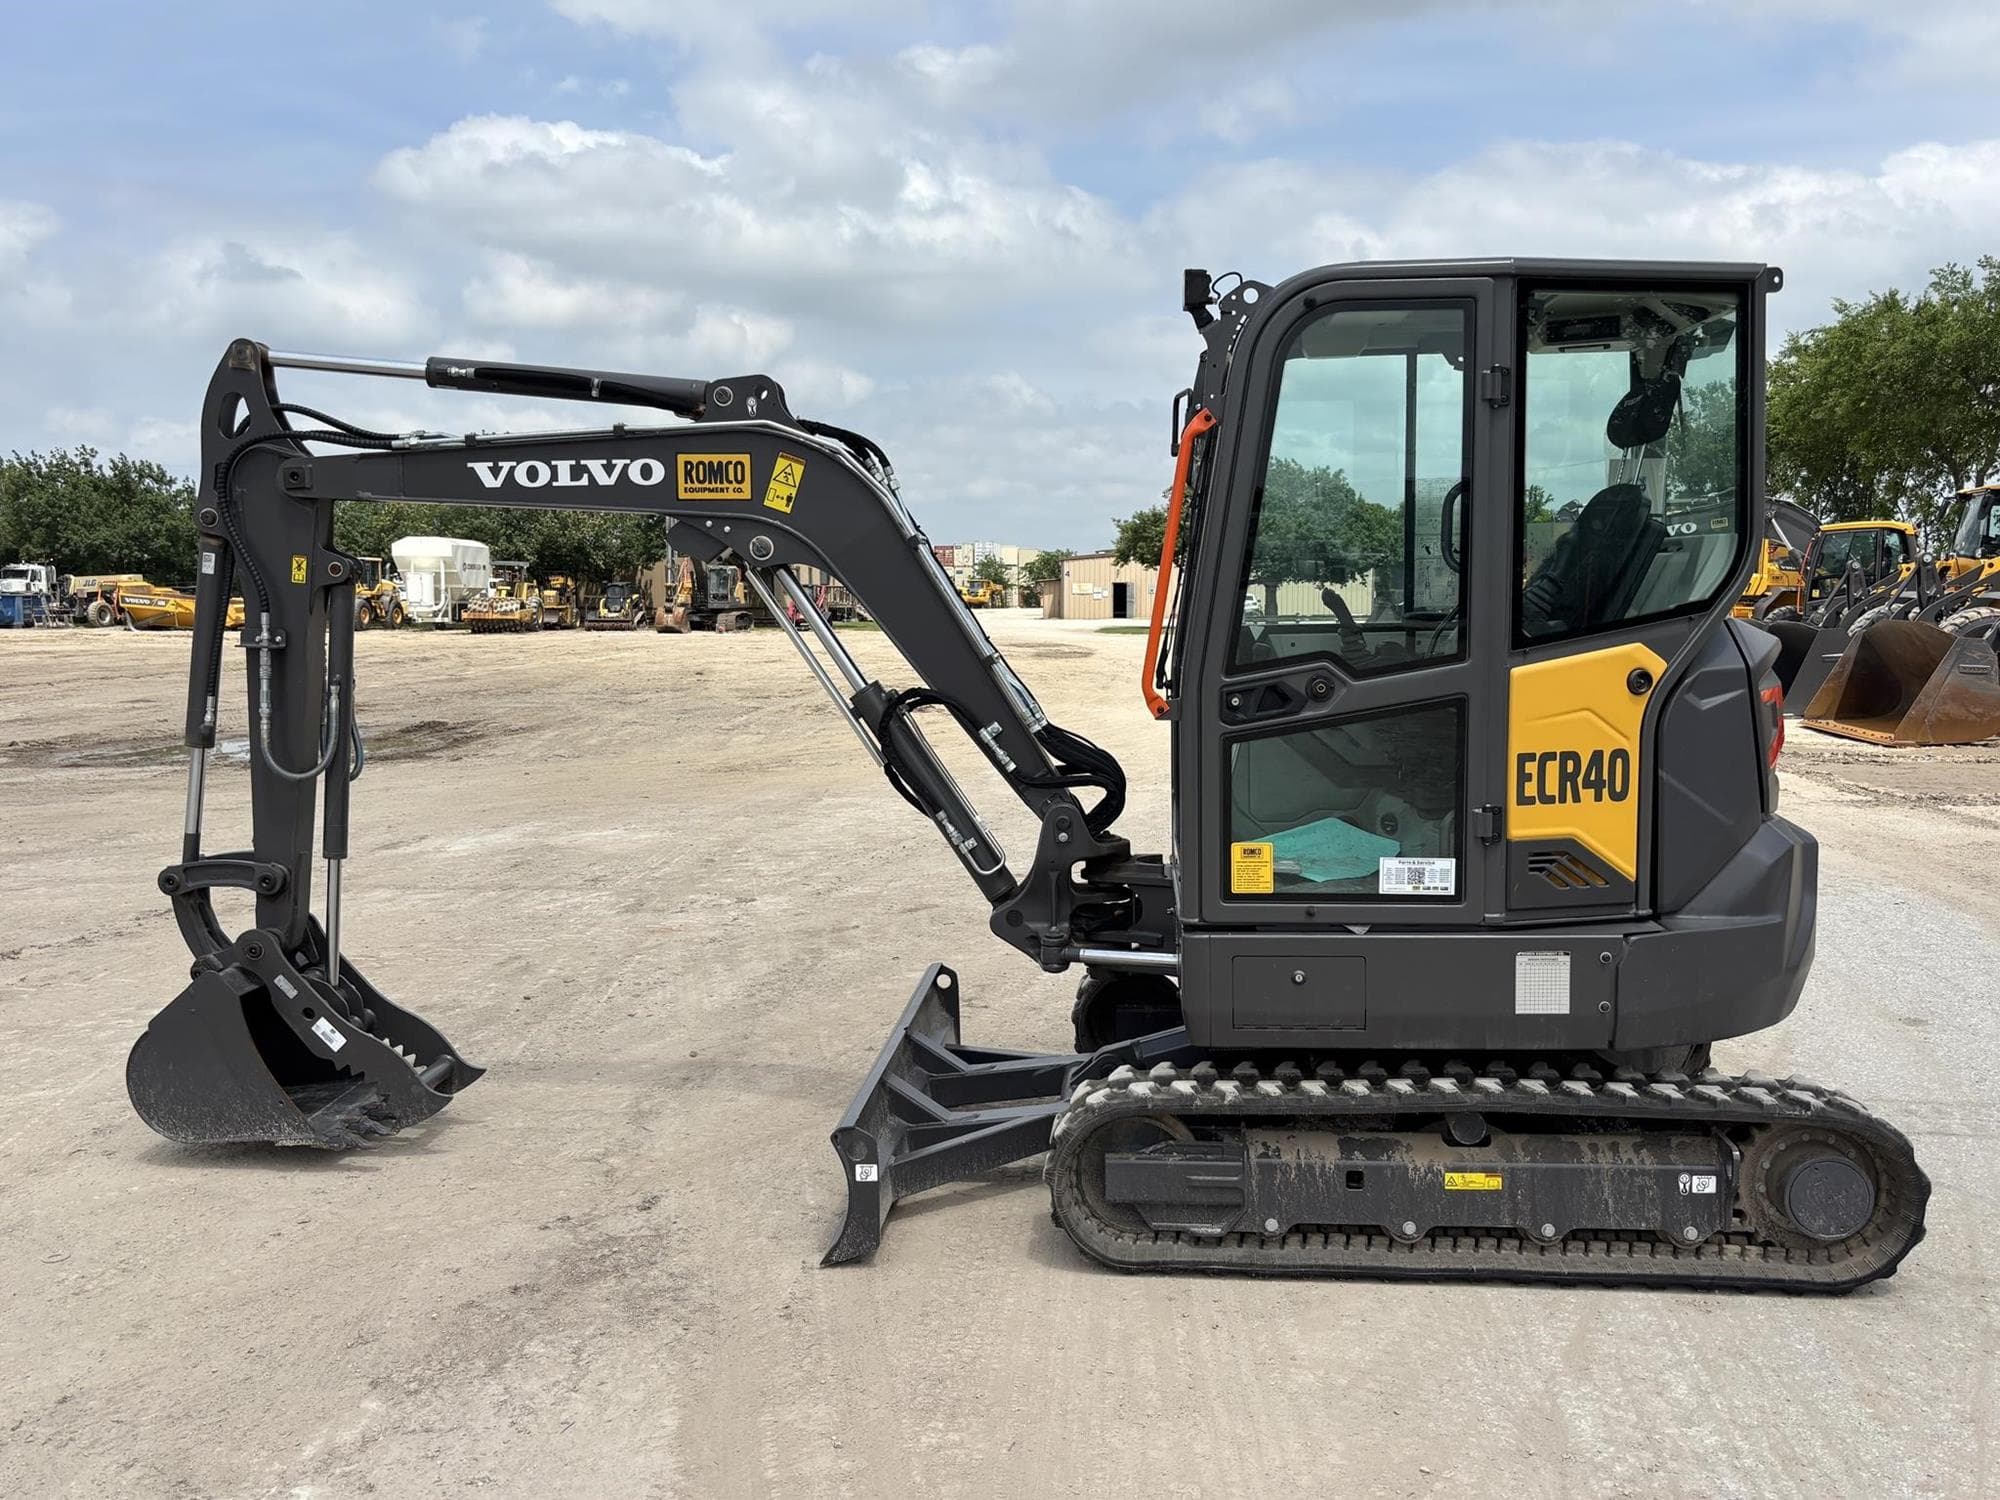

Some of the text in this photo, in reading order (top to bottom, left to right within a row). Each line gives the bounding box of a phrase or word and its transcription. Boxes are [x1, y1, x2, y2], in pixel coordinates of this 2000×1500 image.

[467, 458, 666, 488] VOLVO
[684, 460, 746, 485] ROMCO
[684, 486, 745, 494] EQUIPMENT CO.
[124, 597, 151, 605] VOLVO
[1516, 748, 1631, 806] ECR40
